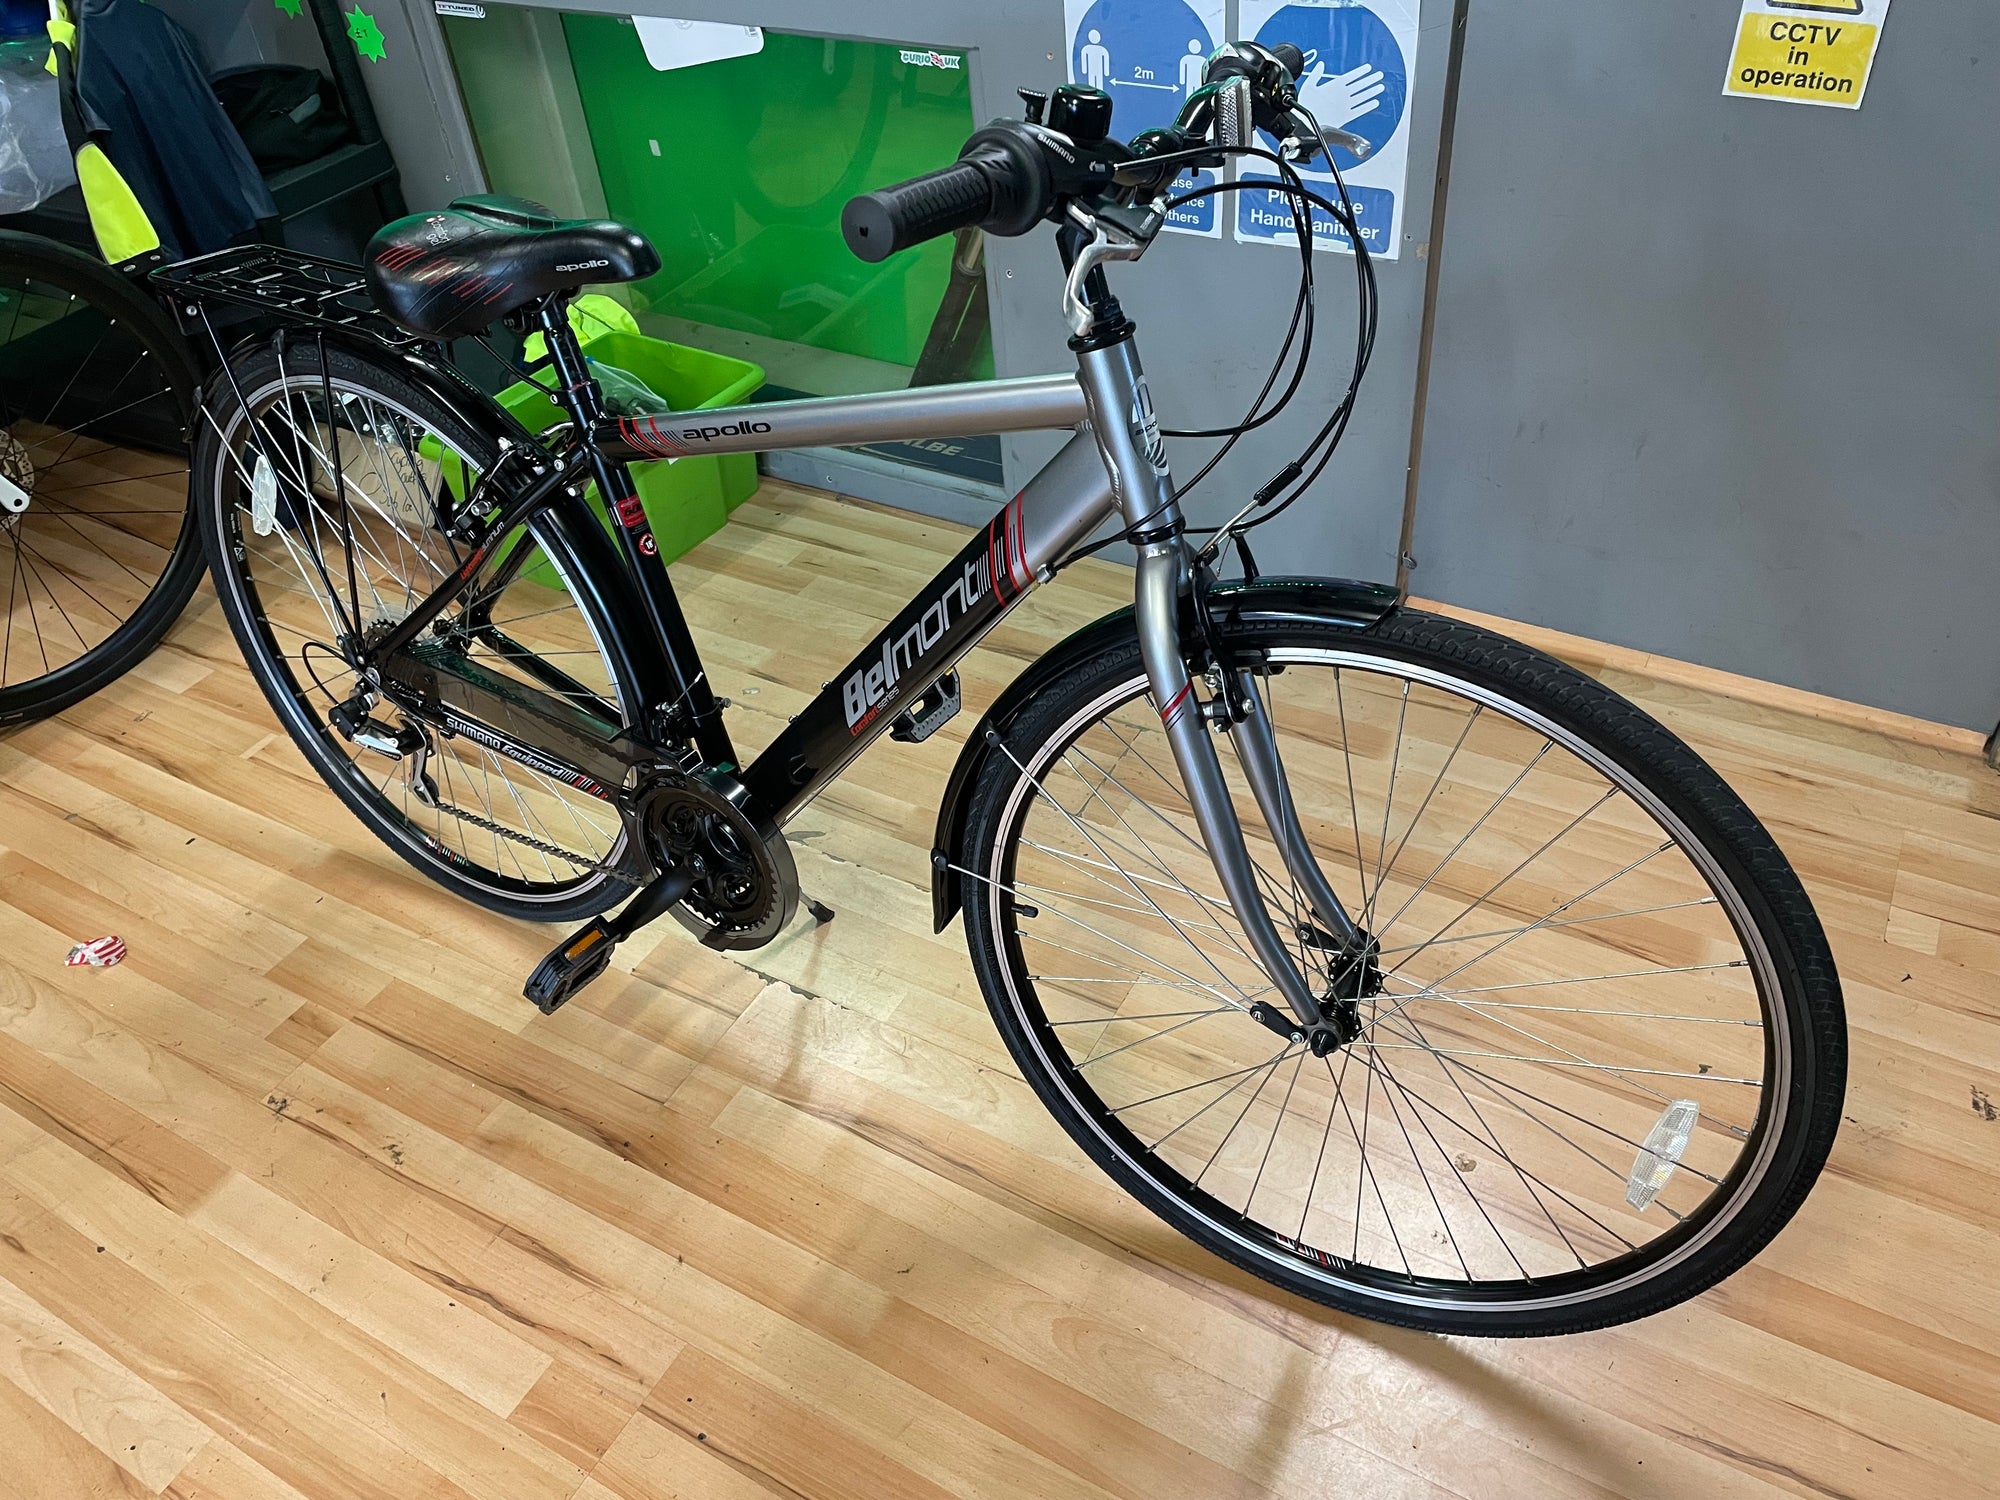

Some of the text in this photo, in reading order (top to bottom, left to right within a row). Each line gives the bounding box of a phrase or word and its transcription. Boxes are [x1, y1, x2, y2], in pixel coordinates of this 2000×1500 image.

[1770, 21, 1841, 46] CCTV
[944, 57, 958, 66] UK
[1787, 46, 1809, 66] in
[1134, 65, 1154, 80] 2m
[1740, 67, 1853, 93] operation
[1037, 133, 1076, 164] SHIMANO
[1165, 209, 1200, 225] thers
[1332, 200, 1364, 215] ue
[1250, 208, 1295, 229] Hand
[426, 233, 441, 247] gel
[431, 220, 450, 244] comfort
[555, 259, 609, 272] apollo
[683, 420, 772, 442] apollo
[842, 561, 981, 729] Belmont
[850, 685, 900, 736] Comfort series
[446, 717, 564, 779] SHIMANO Equipped
